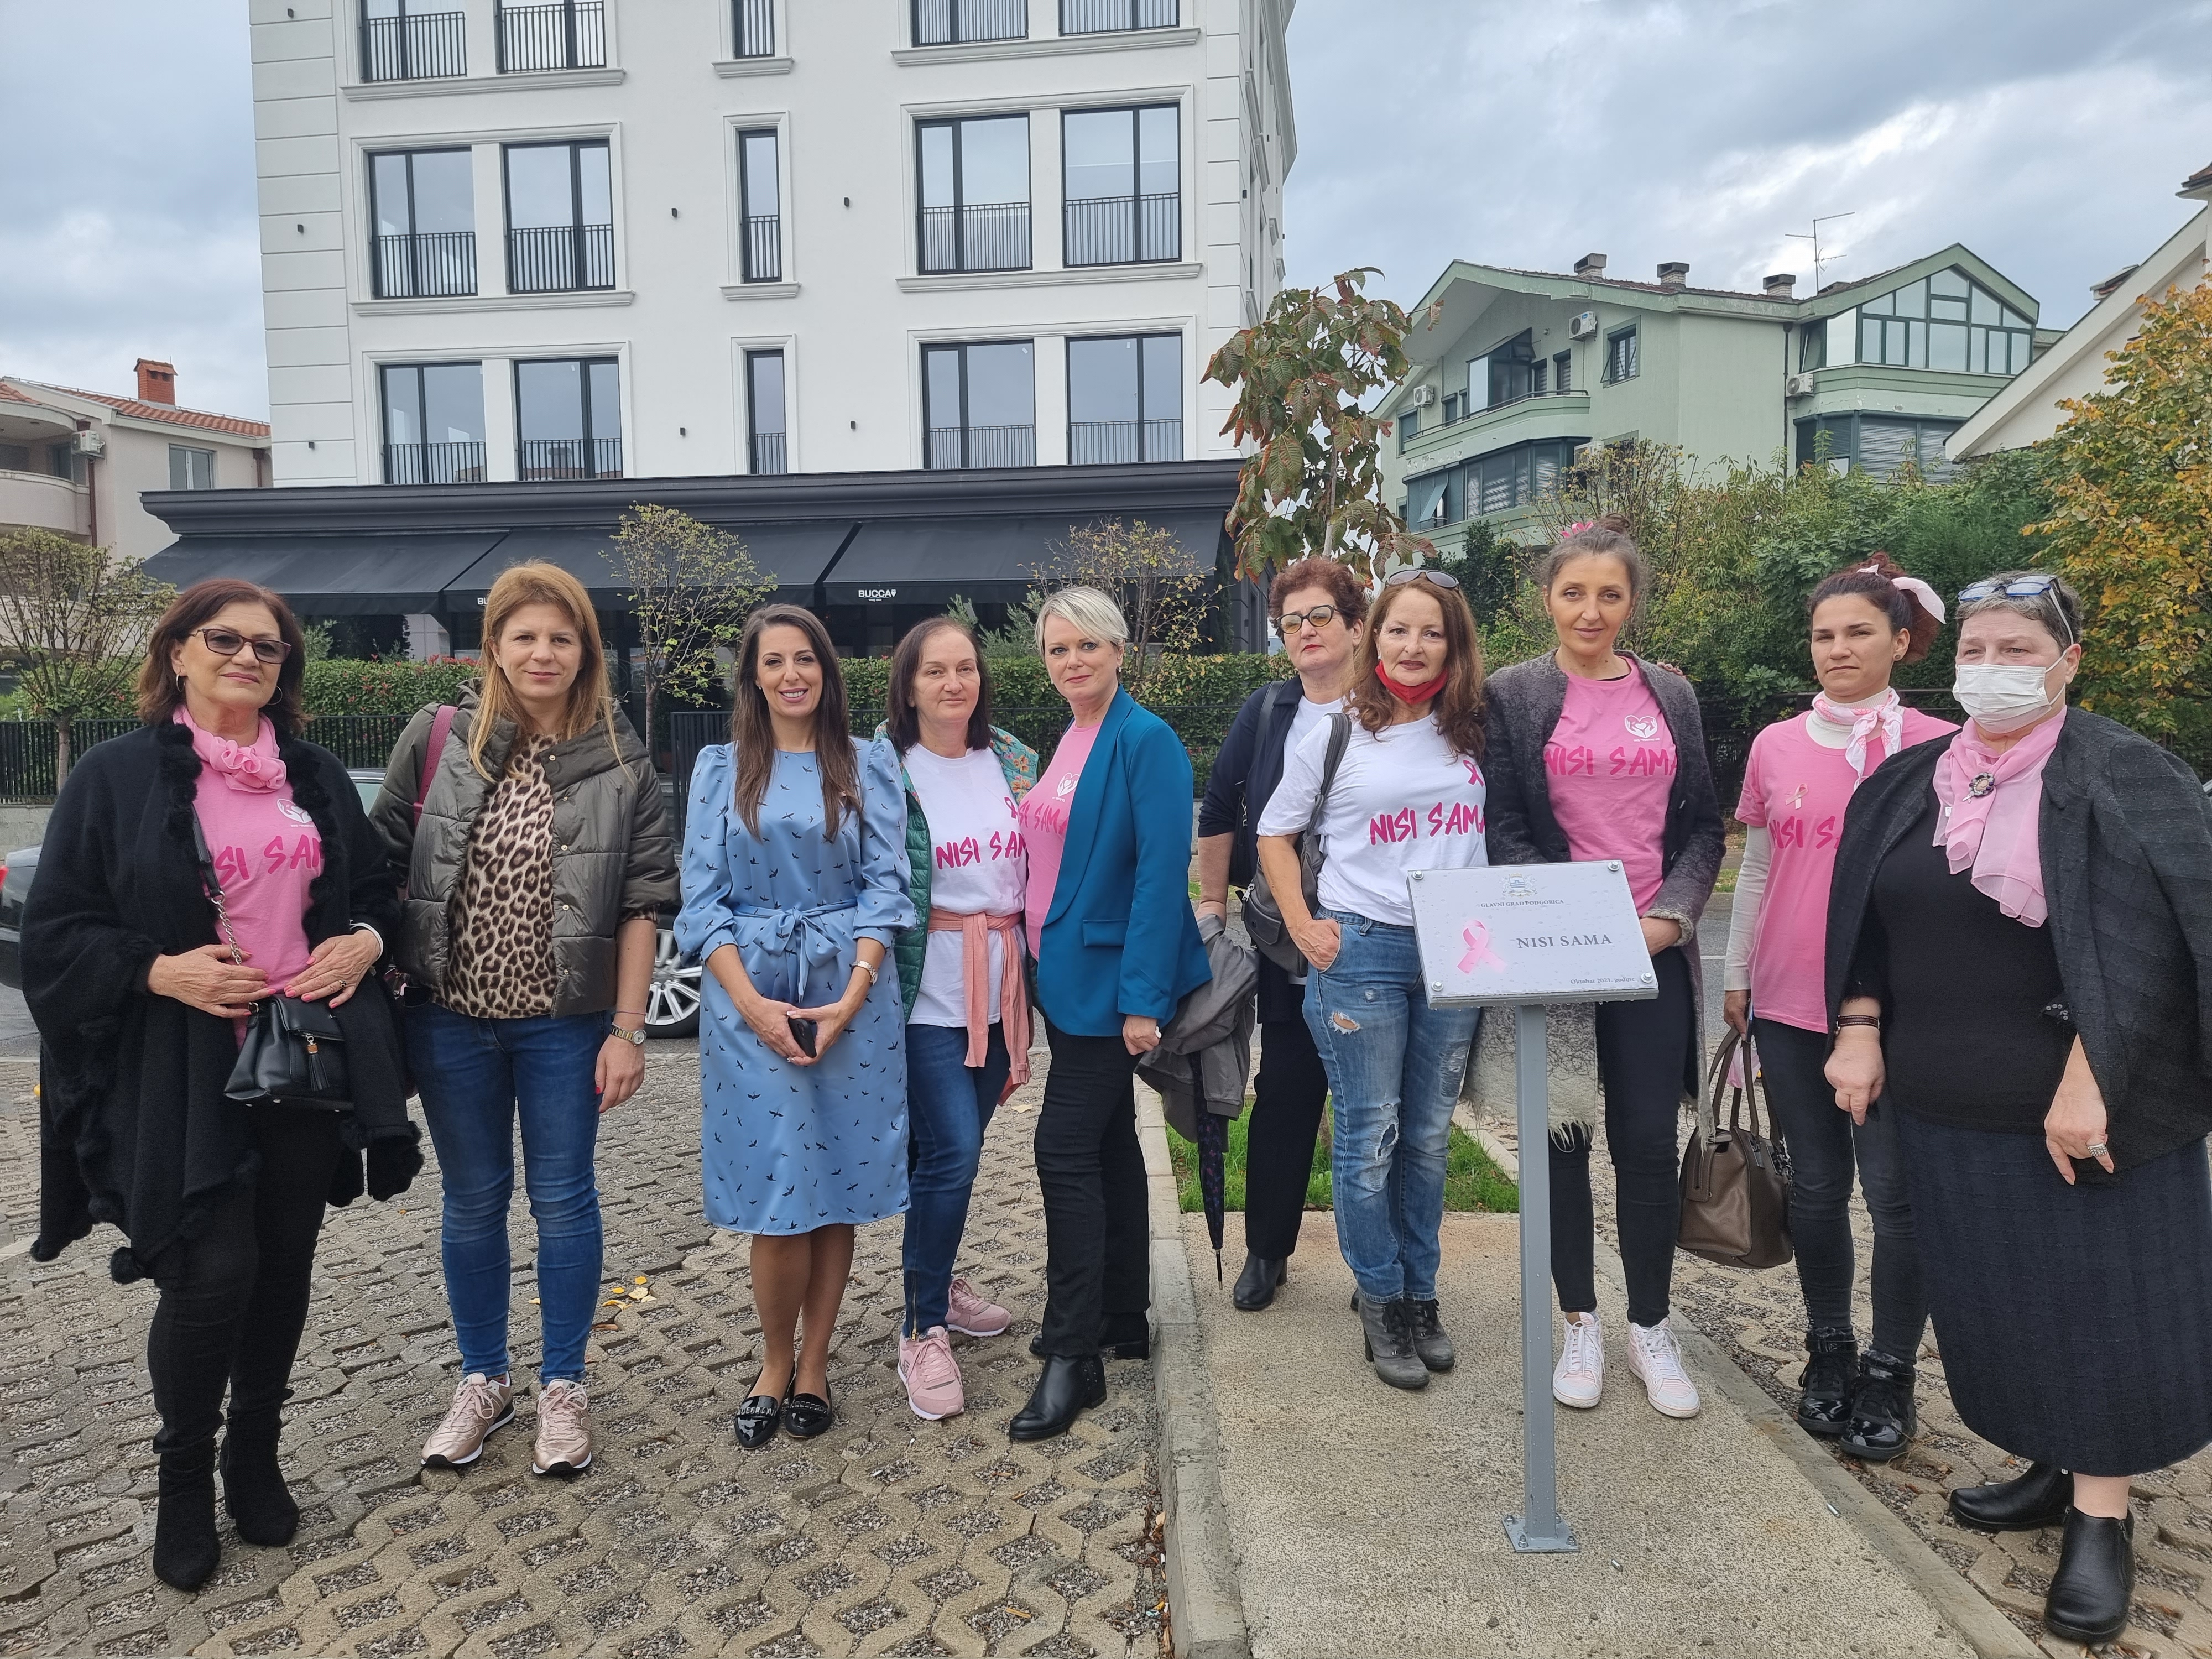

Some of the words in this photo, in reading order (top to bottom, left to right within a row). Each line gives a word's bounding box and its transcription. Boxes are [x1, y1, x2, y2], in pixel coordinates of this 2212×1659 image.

[858, 589, 891, 598] BUCCA
[1018, 800, 1031, 828] SI
[1370, 807, 1417, 845] NISI
[215, 846, 249, 886] SI
[936, 836, 980, 869] NISI
[989, 831, 1026, 860] SAM
[1516, 936, 1554, 948] NISI
[1560, 934, 1613, 946] SAMA
